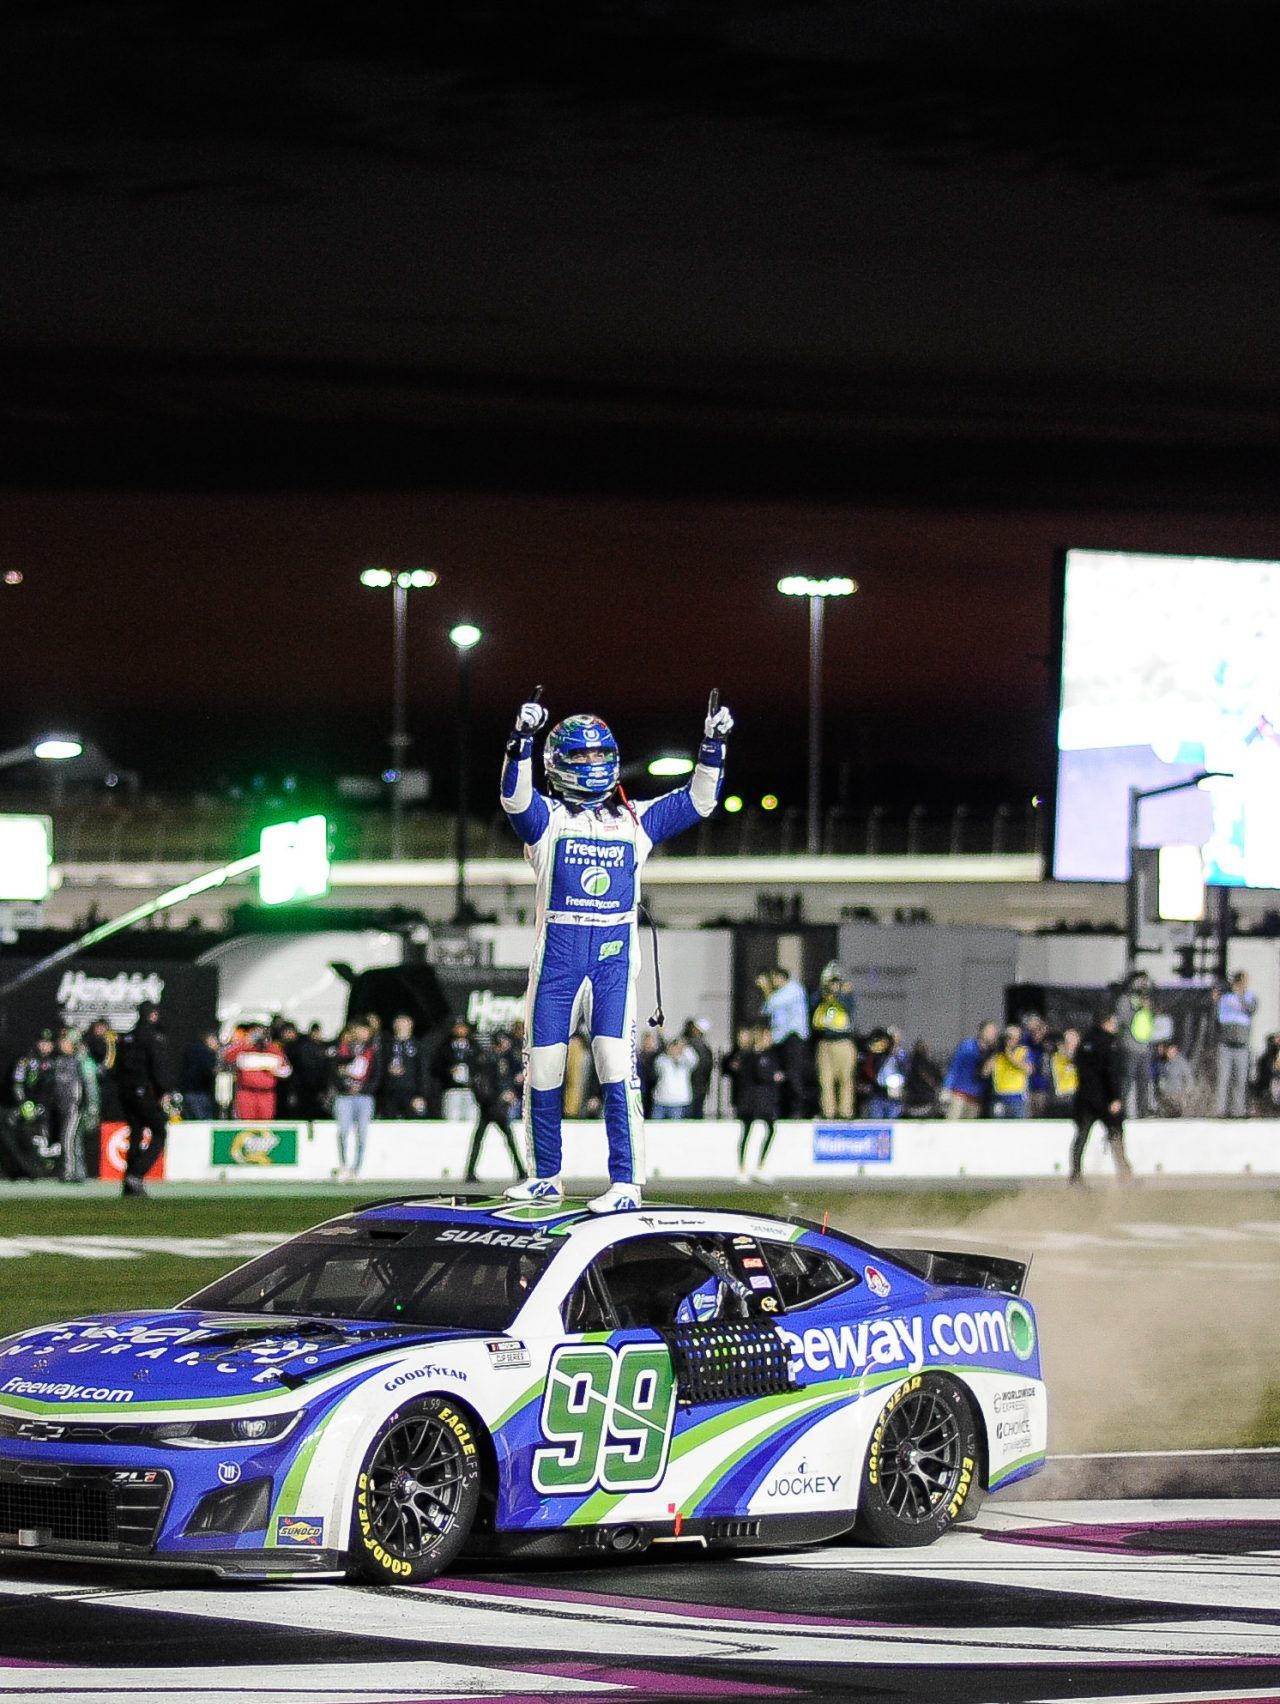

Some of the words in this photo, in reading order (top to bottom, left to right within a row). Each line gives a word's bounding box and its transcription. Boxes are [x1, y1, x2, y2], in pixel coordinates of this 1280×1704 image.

[565, 839, 625, 860] Freeway
[565, 896, 620, 909] Freeway.com
[0, 1376, 134, 1402] Freeway.com
[384, 1364, 468, 1392] GOODYEAR
[438, 1407, 477, 1456] EAGLE
[532, 1342, 675, 1494] 99
[767, 1475, 842, 1497] JOCKEY
[948, 1457, 974, 1518] EAGLE
[280, 1527, 321, 1536] SUNOCO
[358, 1472, 412, 1577] GOODYEAR
